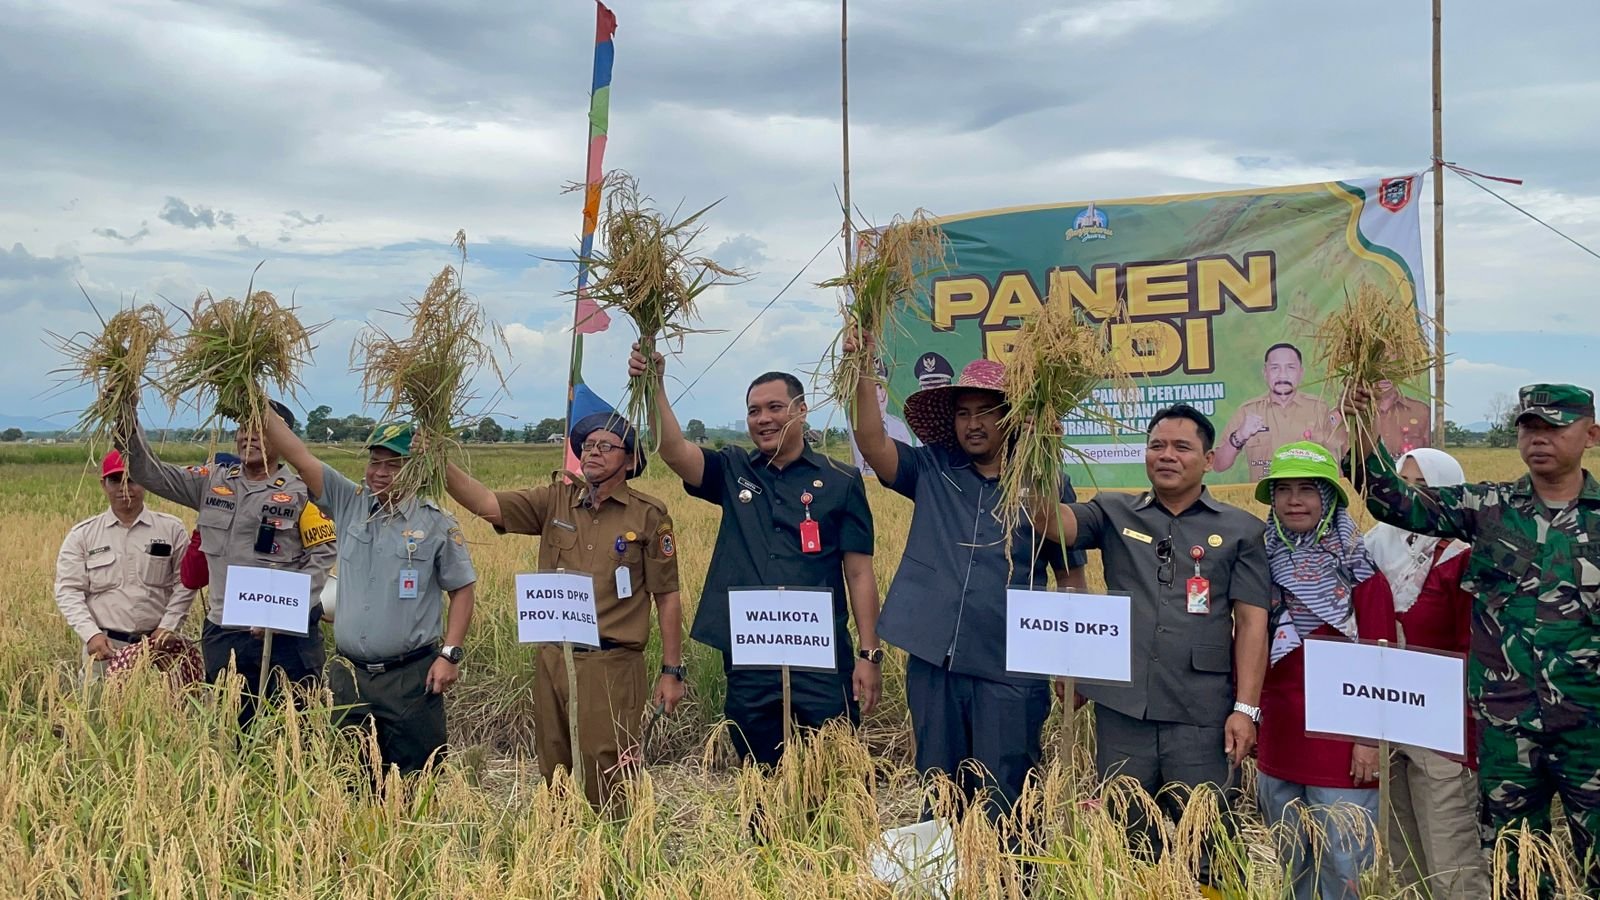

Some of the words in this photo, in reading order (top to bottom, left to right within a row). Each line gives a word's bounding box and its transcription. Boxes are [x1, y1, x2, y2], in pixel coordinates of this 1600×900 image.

[933, 254, 1274, 330] PANEN
[984, 317, 1211, 378] PDI
[1147, 383, 1224, 402] PERTANIAN
[1084, 448, 1141, 459] September
[261, 504, 294, 518] POLRI
[238, 591, 299, 607] KAPOLRES
[526, 589, 565, 599] KADIS
[567, 590, 589, 602] DPKP
[520, 610, 559, 620] PROV.
[562, 610, 596, 625] KALSEL
[745, 610, 819, 623] WALIKOTA
[1020, 617, 1069, 633] KADIS
[1075, 622, 1119, 637] DKP3
[736, 634, 830, 647] BANJARBARU
[1342, 682, 1425, 707] DANDIM
